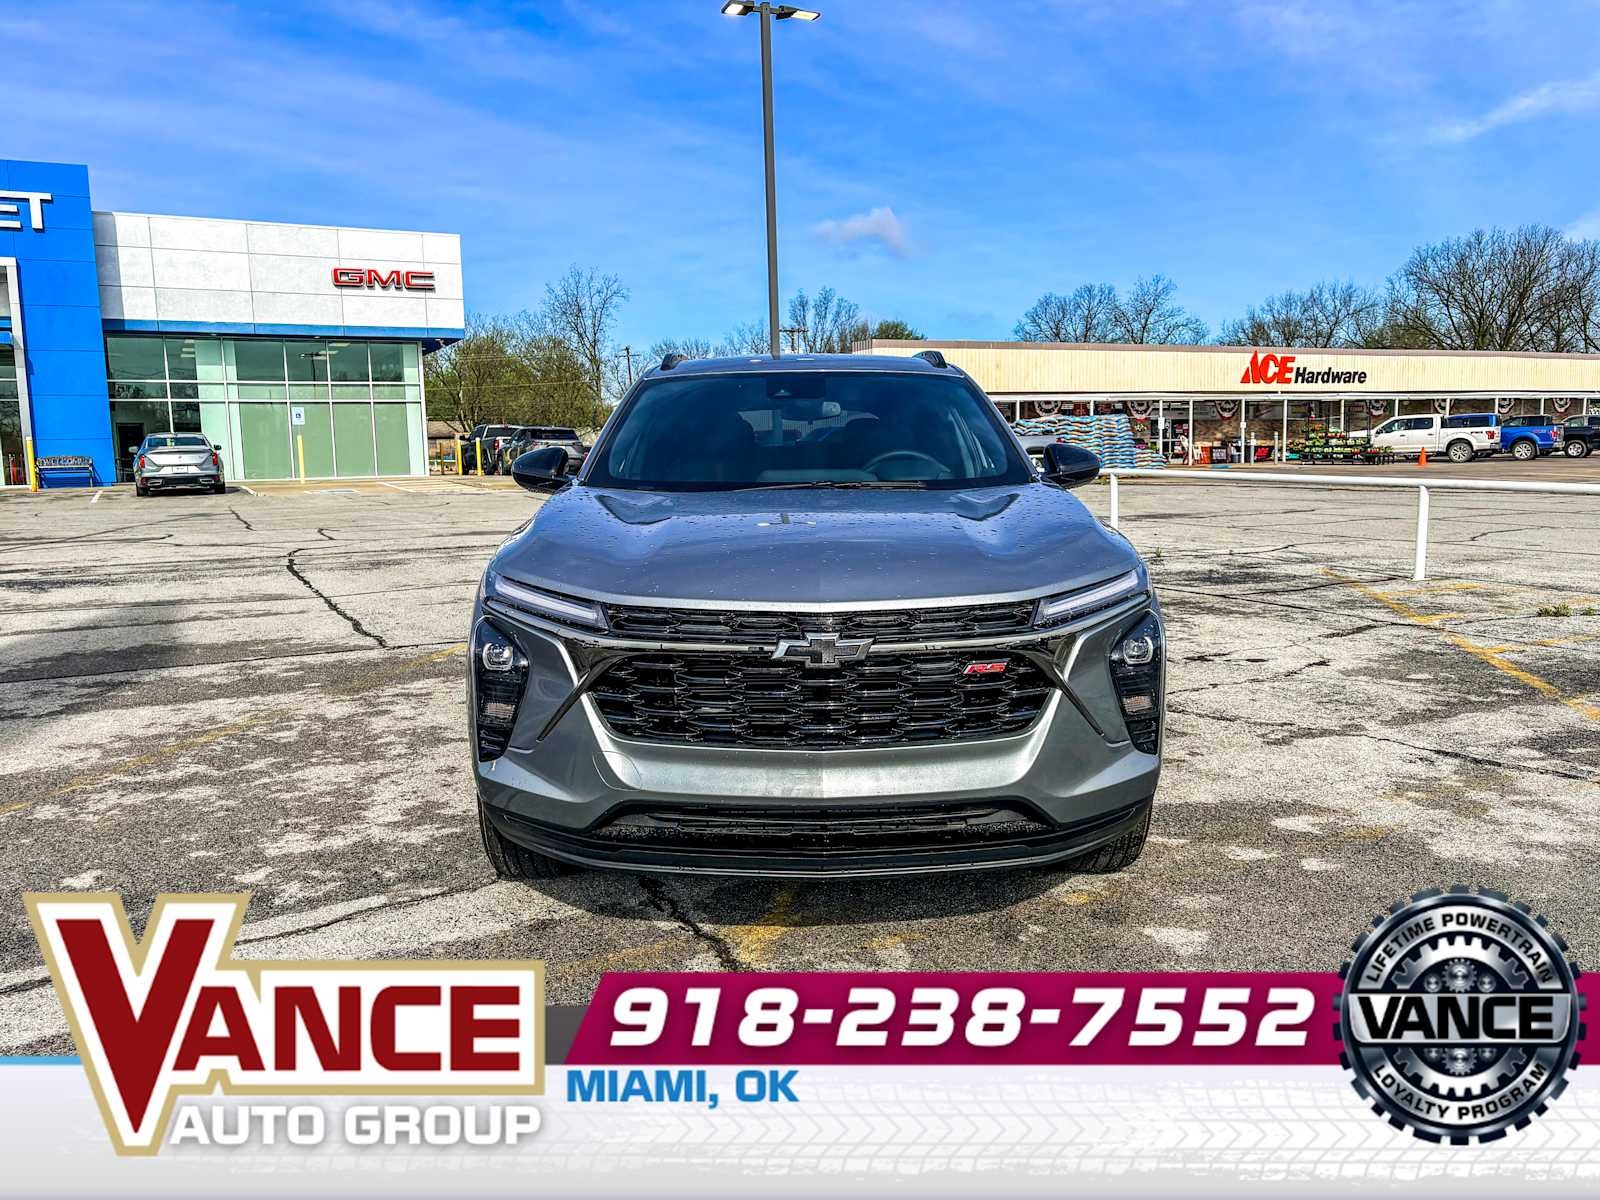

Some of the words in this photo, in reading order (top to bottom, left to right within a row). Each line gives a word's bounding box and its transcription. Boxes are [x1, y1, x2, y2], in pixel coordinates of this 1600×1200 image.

[332, 268, 435, 290] GMC
[1240, 350, 1296, 384] ACE
[1294, 367, 1367, 384] Hardware
[963, 662, 1007, 674] RS
